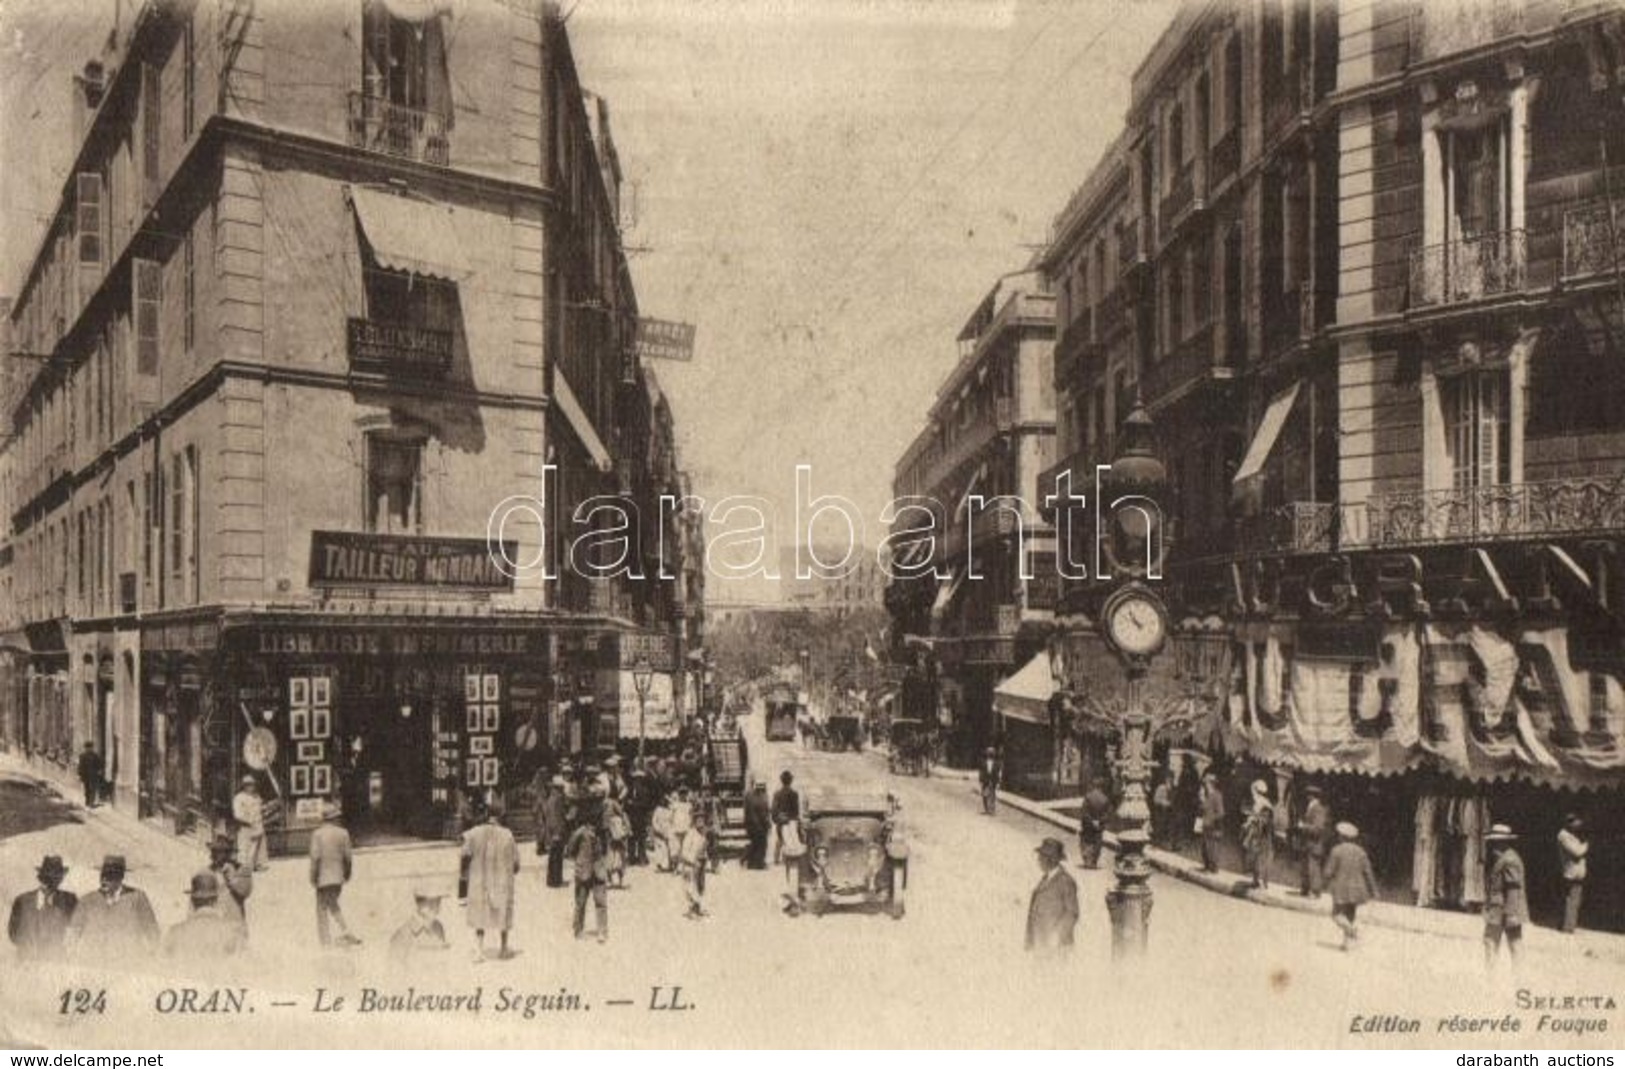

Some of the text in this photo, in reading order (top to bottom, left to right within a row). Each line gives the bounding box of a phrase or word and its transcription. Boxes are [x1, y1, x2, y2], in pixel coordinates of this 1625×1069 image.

[402, 543, 431, 555] AU
[324, 543, 505, 584] TAILLEUR MONDAIN
[258, 633, 528, 654] LIBRAIRIE IMPRIMERIE
